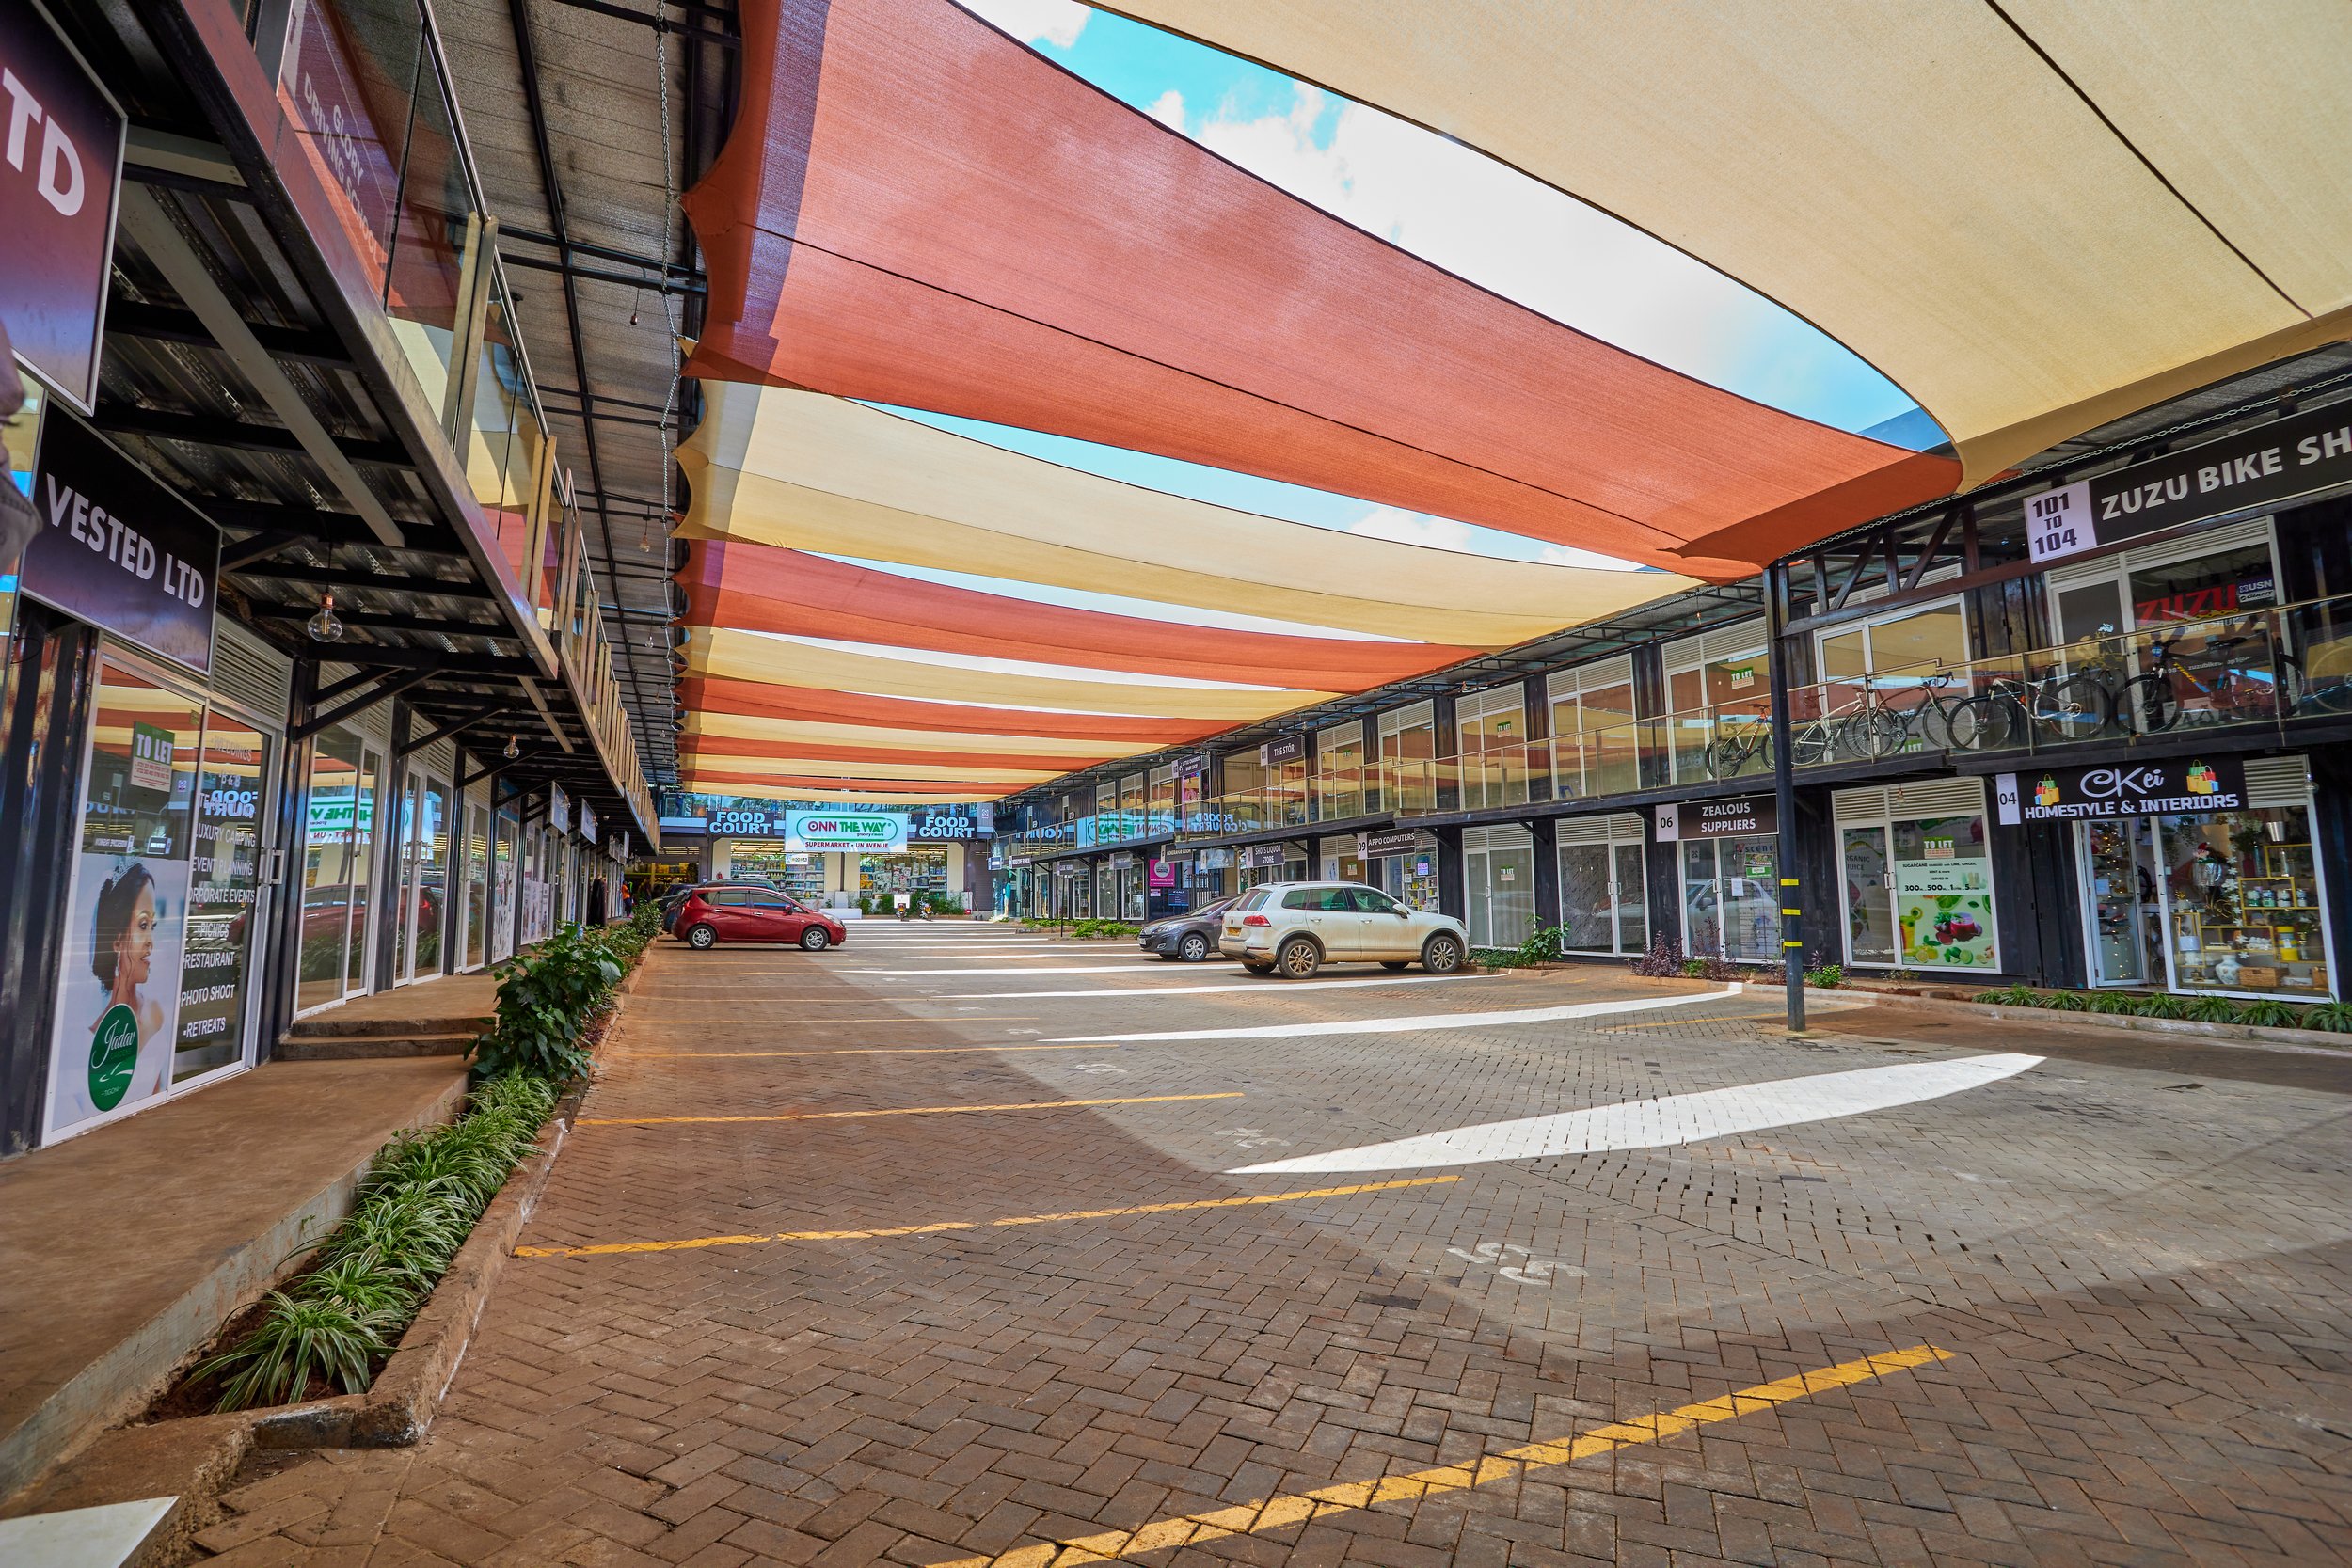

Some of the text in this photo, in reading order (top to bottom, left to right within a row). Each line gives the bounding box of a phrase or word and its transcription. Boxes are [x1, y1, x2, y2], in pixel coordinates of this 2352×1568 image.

[333, 104, 364, 186] GLORY
[304, 71, 380, 266] DRIVING SCHOOL
[2100, 473, 2189, 521] ZUZU
[2198, 447, 2284, 494] BIKE
[2032, 492, 2070, 518] 101
[2044, 515, 2063, 531] TO
[46, 472, 205, 609] VESTED LTD
[2034, 528, 2077, 555] 104
[2249, 579, 2273, 591] USN
[2247, 590, 2274, 599] GIANT
[2137, 583, 2236, 622] ZUZU
[1731, 670, 1752, 681] TO LET
[136, 734, 173, 764] TO LET
[1274, 747, 1282, 756] THE
[1908, 743, 1922, 752] LET
[1998, 793, 2017, 805] 04
[2025, 793, 2239, 819] HOMESTYLE & INTERIORS
[1701, 802, 1751, 816] ZEALOUS
[716, 812, 766, 823] FOOD
[925, 816, 969, 828] FOOD
[1660, 816, 1673, 829] 06
[709, 822, 771, 834] COURT
[807, 820, 886, 832] ONN THE WAY
[1701, 818, 1756, 832] SUPPLIERS
[225, 829, 256, 847] CAMPING
[919, 827, 975, 838] COURT
[1368, 832, 1415, 847] APPO COMPUTERS
[1255, 845, 1281, 855] SHOTS LIQUOR
[1358, 841, 1366, 852] 09
[1924, 840, 1953, 849] TO LET
[192, 856, 254, 876] EVENT PLANNING
[1262, 855, 1275, 864] STORE
[188, 887, 255, 904] ORPORATE EVENTS
[180, 984, 235, 1008] PHOTO SHOOT
